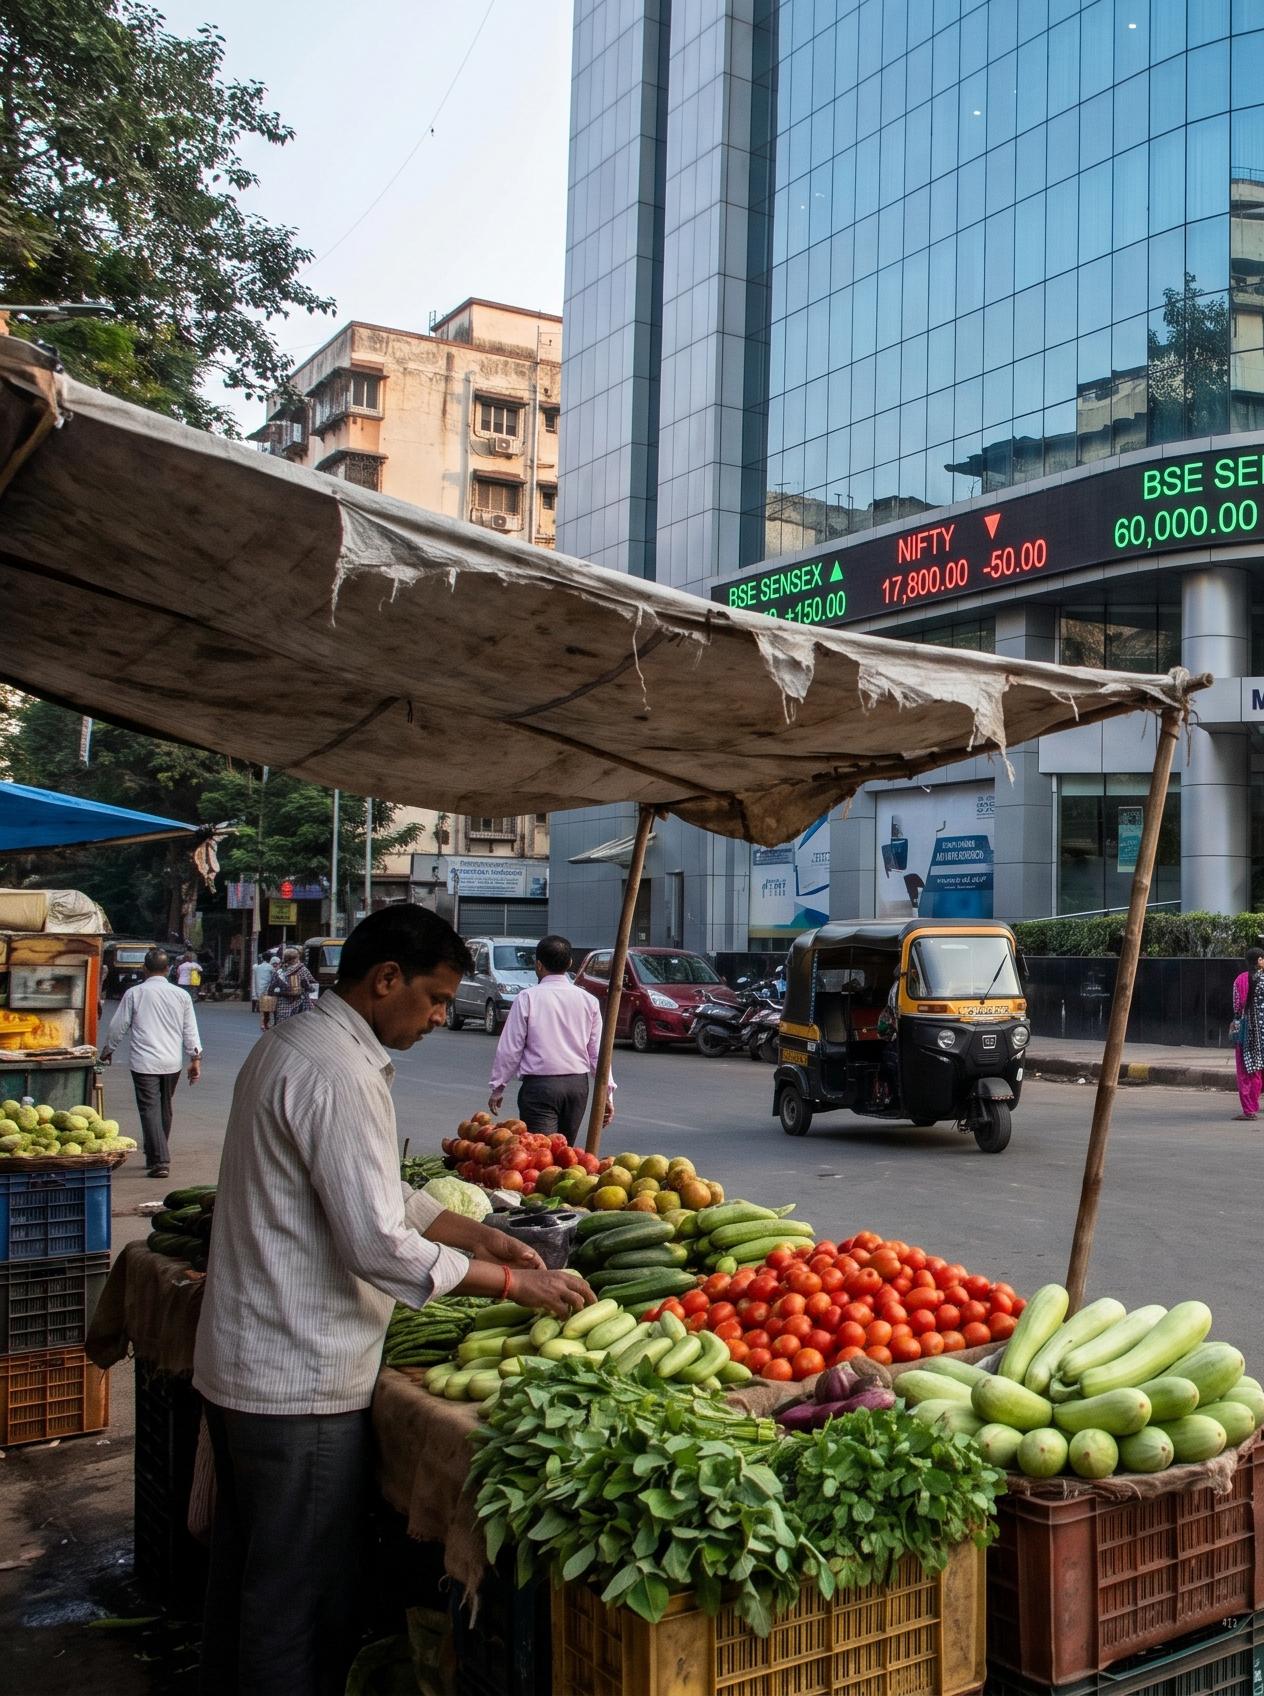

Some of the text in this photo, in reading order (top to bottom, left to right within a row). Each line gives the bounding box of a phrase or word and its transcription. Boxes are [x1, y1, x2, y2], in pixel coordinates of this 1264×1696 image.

[1143, 462, 1204, 500] BSE
[898, 524, 956, 564] NIFTY
[1113, 499, 1259, 549] 60,000.00
[729, 562, 823, 609] BSE SENSEX
[882, 538, 1047, 605] 17,800.00 -50.00
[785, 590, 846, 625] +150.00
